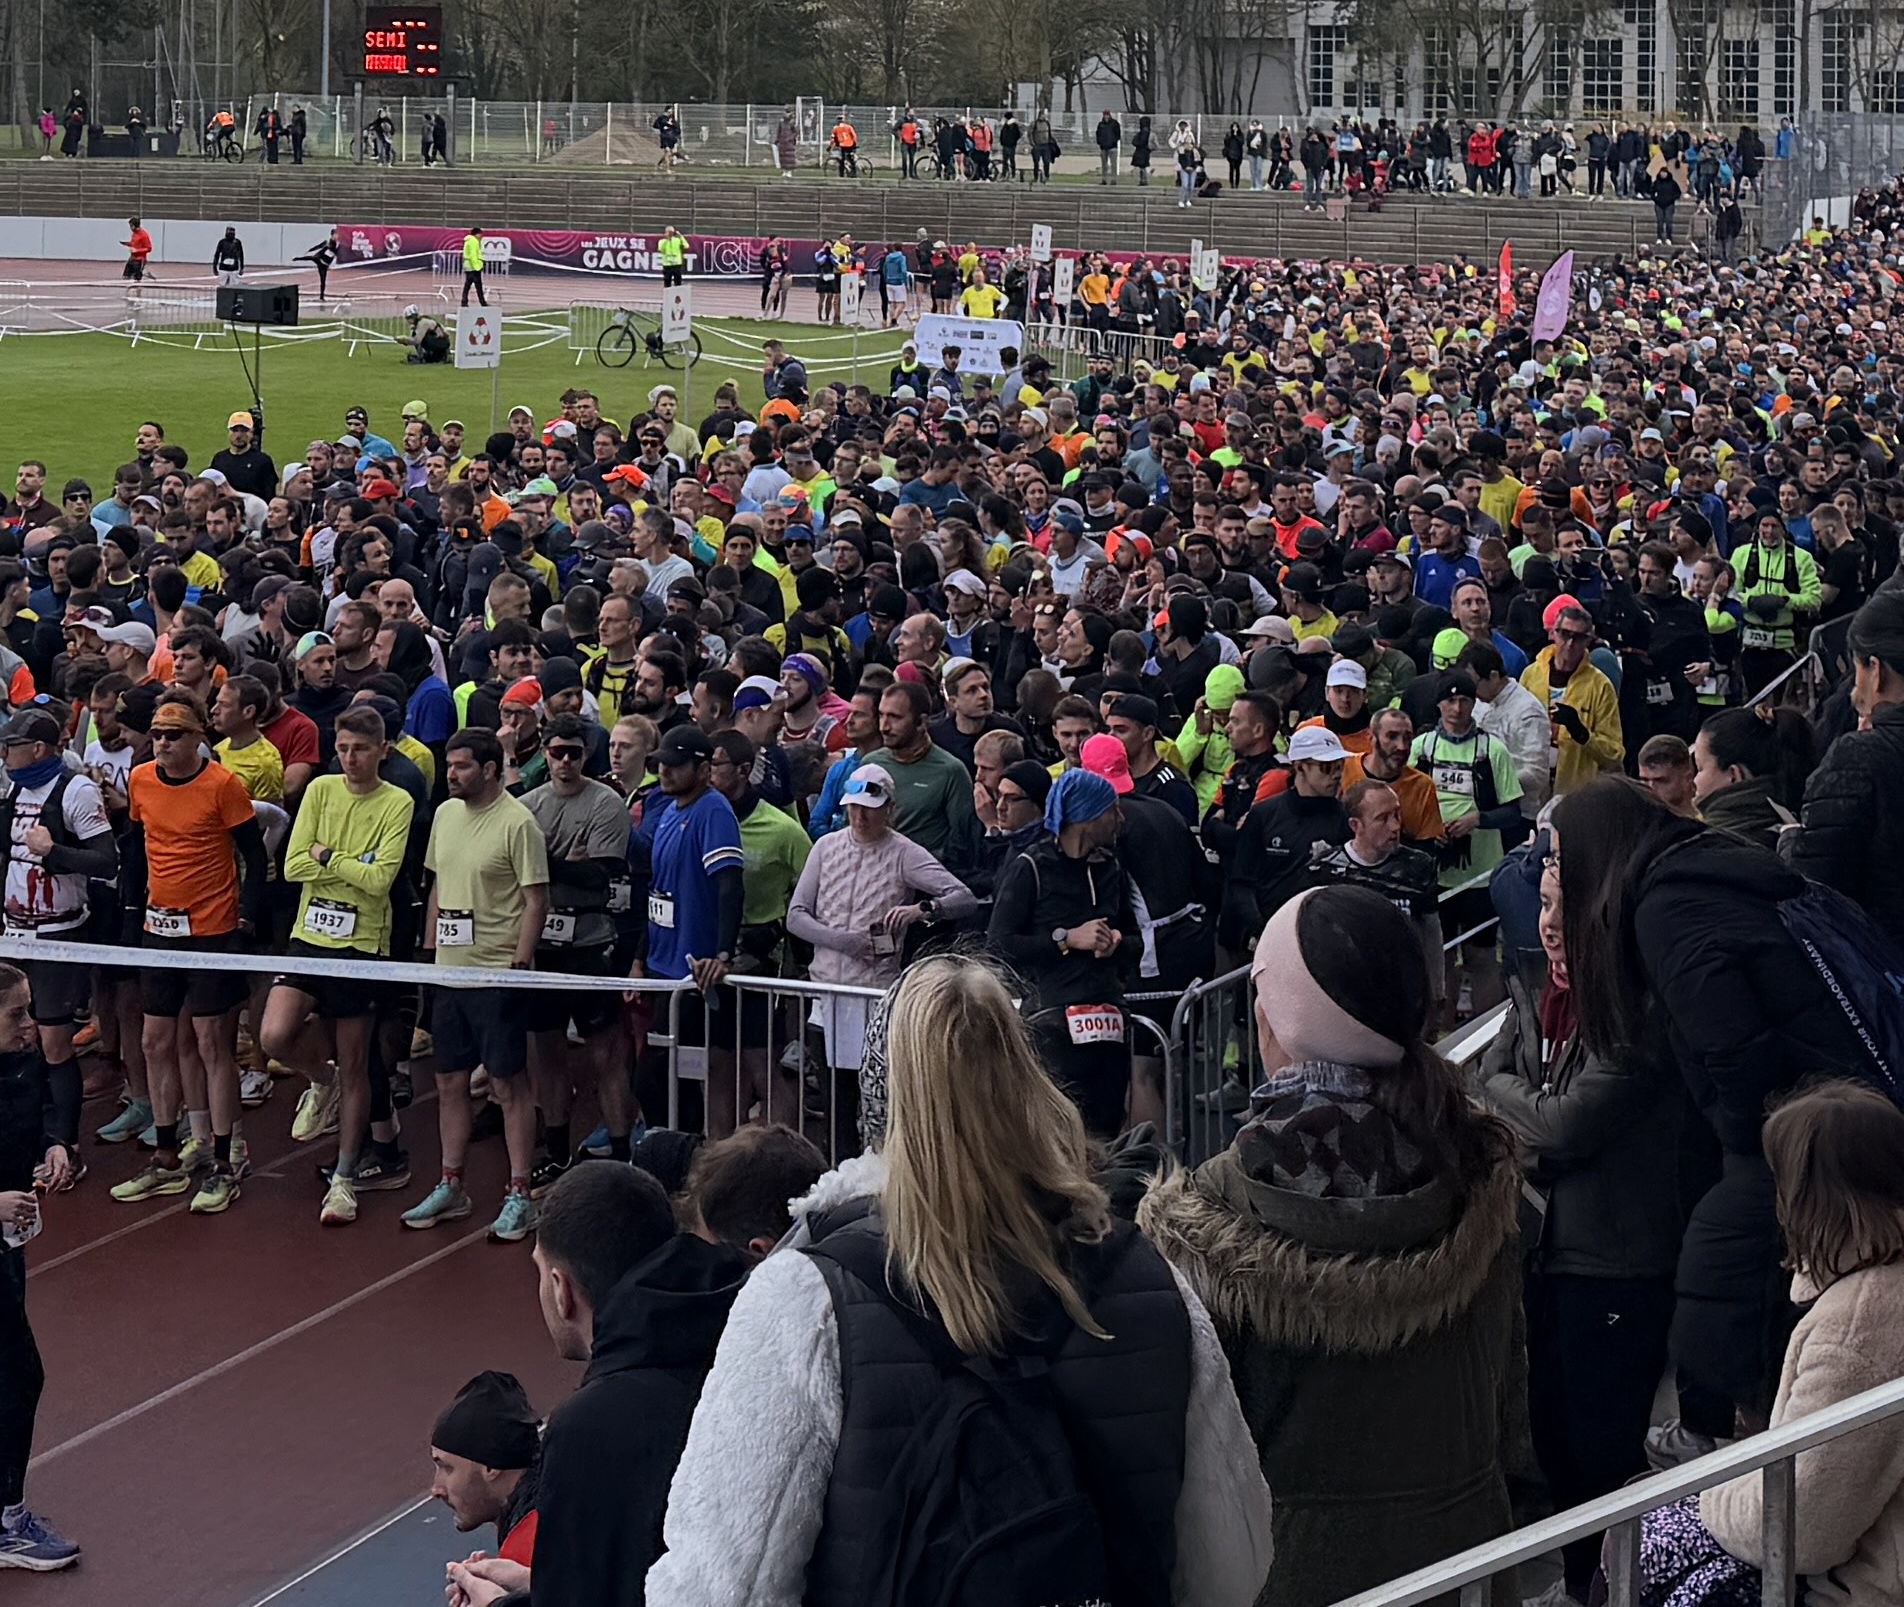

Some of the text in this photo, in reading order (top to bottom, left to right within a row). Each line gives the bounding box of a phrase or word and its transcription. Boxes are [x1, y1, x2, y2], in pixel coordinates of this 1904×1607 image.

[365, 31, 406, 48] SEMI
[595, 237, 627, 250] JEUX
[630, 238, 646, 250] SE
[583, 250, 697, 272] GAGNET
[703, 241, 751, 274] ICI
[313, 911, 344, 928] 1937
[1802, 937, 1862, 1027] EXTRAORDINARY
[1075, 1016, 1121, 1034] 3001A
[1857, 1027, 1879, 1058] YOUR
